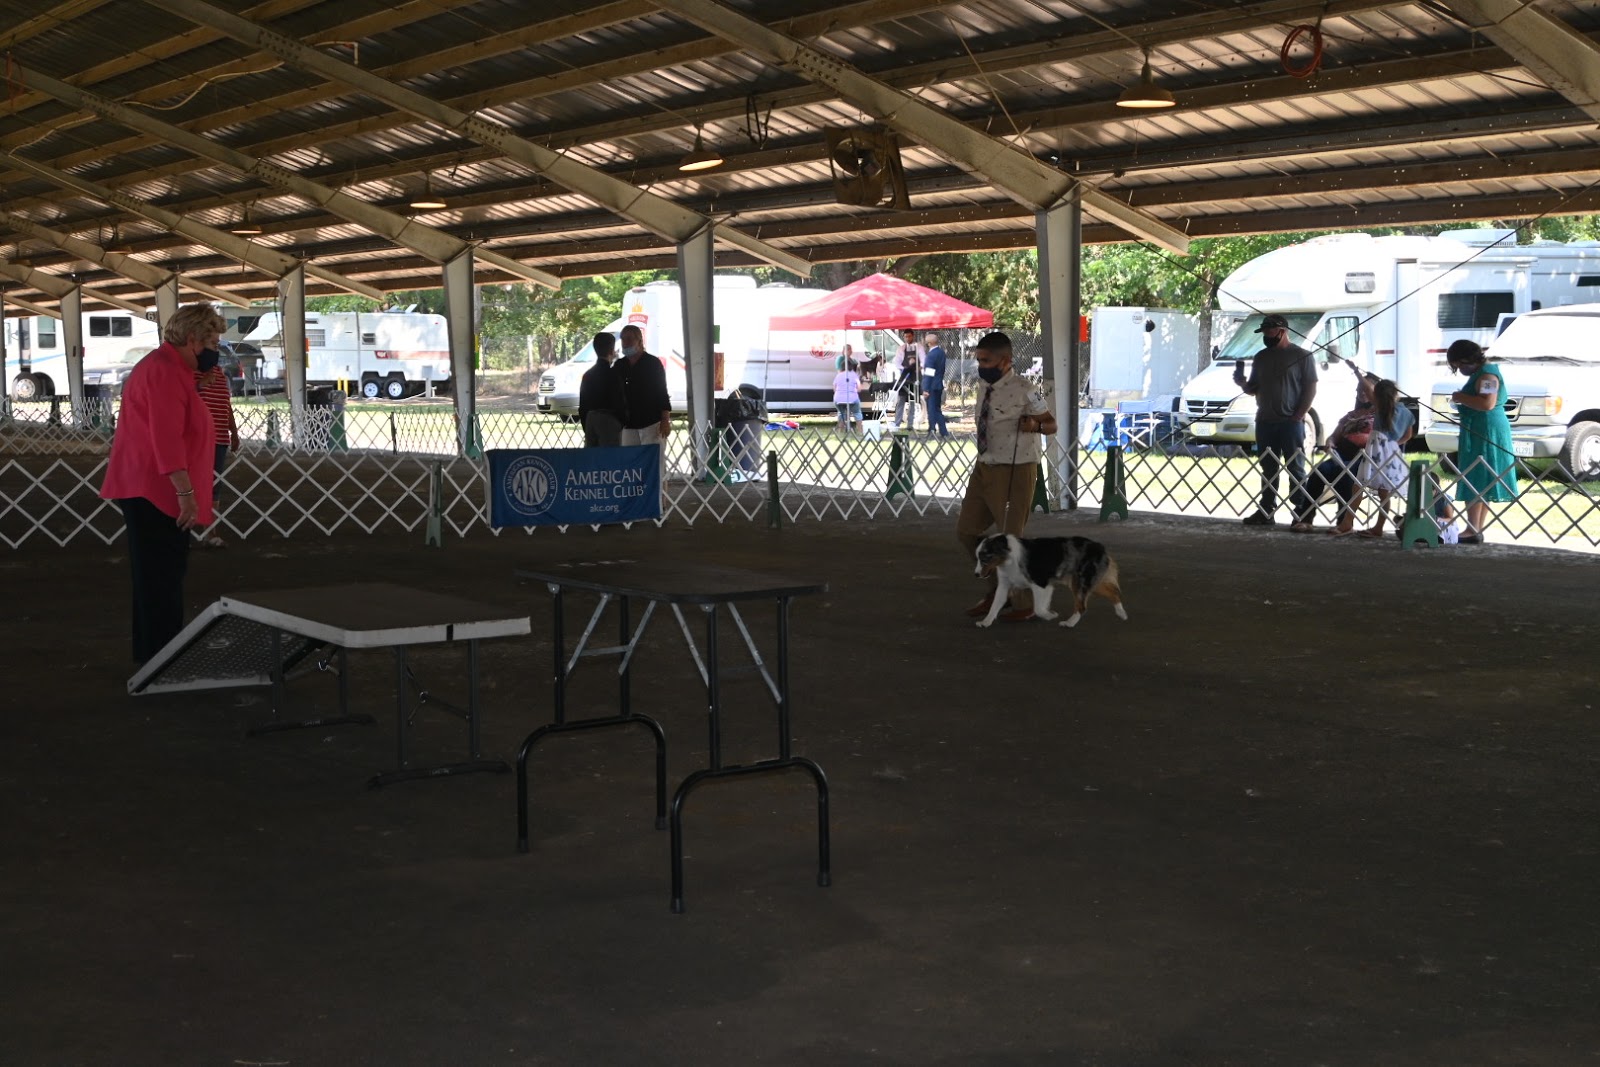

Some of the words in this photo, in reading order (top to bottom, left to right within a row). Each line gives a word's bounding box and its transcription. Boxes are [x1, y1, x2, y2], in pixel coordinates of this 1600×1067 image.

[506, 459, 526, 490] AMERICAN
[526, 458, 550, 474] KENNEL
[547, 470, 556, 490] CLUB
[565, 468, 642, 486] AMERICAN
[515, 468, 547, 504] AKC
[564, 487, 609, 501] KENNEL
[589, 503, 620, 513] akc.org
